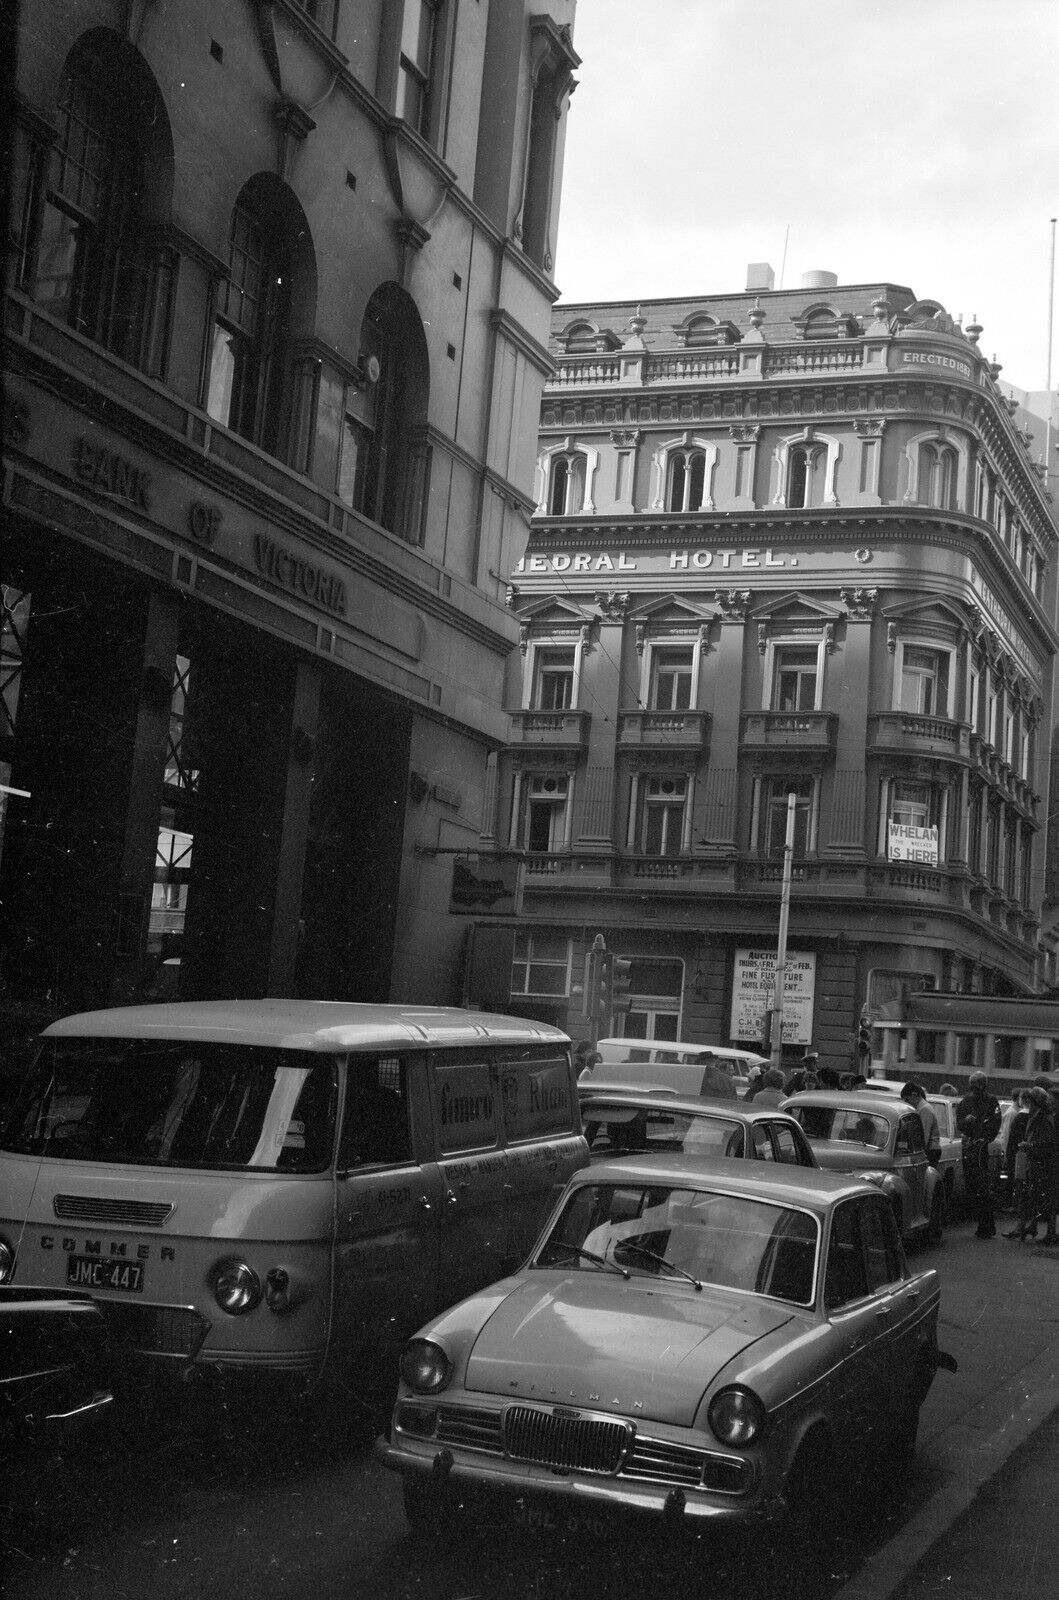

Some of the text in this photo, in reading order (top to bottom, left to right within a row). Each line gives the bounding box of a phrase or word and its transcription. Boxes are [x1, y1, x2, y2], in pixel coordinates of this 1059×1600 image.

[903, 352, 956, 369] ERECTED
[72, 436, 345, 616] BANK OF VICTORIA
[890, 824, 938, 842] WHELAN
[889, 846, 937, 863] IS HERE
[748, 952, 779, 960] AUCTIO
[742, 971, 757, 979] FINE
[761, 971, 803, 981] FURTURE
[741, 981, 758, 989] HOTEL
[40, 1234, 175, 1261] COMMER
[69, 1261, 140, 1289] JMC 447
[509, 1381, 643, 1409] HILLMAN
